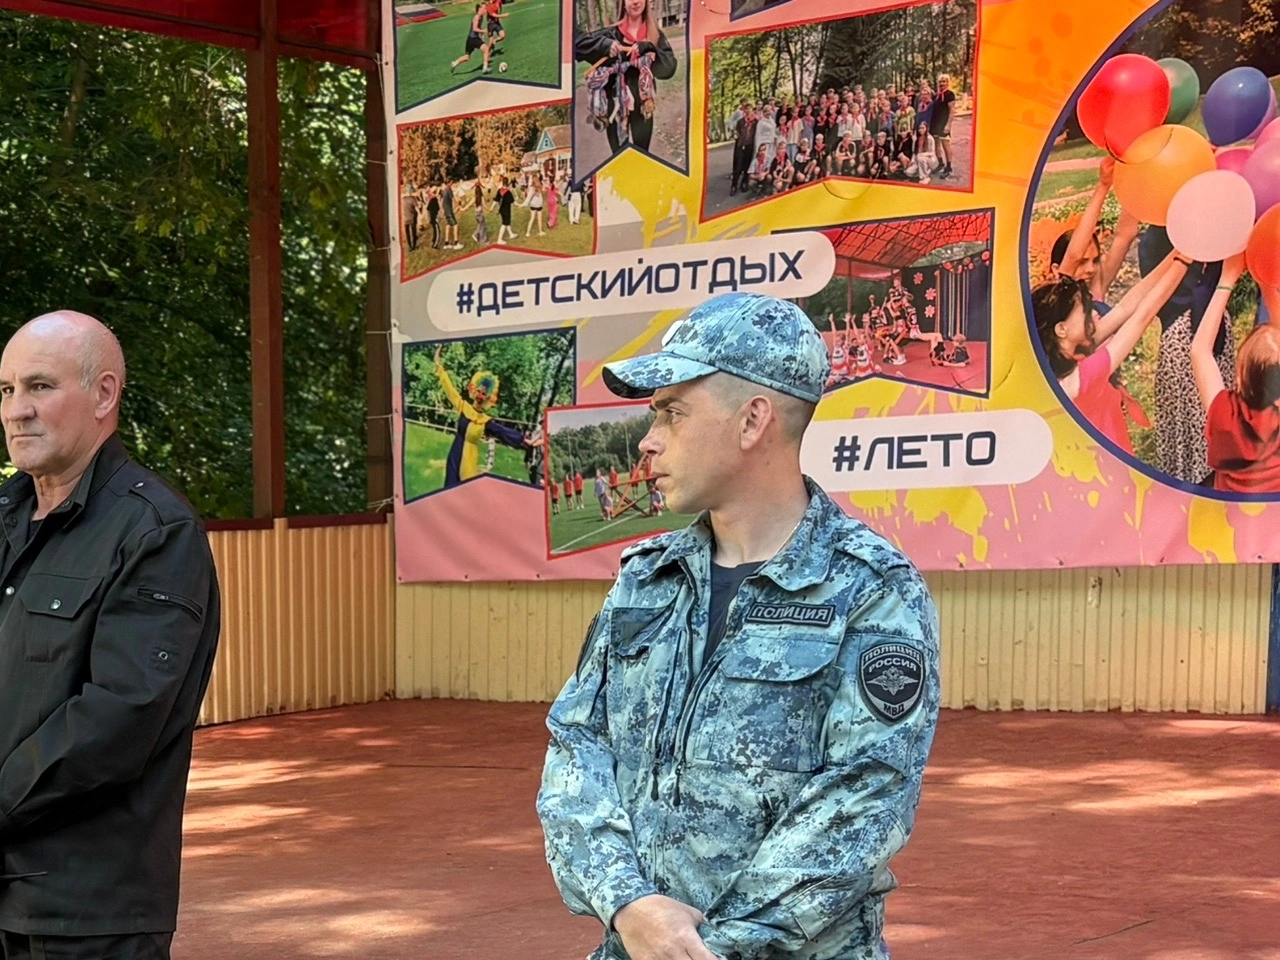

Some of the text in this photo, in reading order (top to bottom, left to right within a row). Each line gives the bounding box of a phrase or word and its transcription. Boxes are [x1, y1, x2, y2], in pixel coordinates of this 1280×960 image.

[456, 250, 805, 317] #ДЕТСКИЙОТДЫХ
[832, 431, 996, 472] #ЛЕТО
[751, 606, 829, 620] ПОЛИЦИЯ
[865, 645, 920, 661] ПОЛИЦИЯ
[868, 657, 917, 673] РОССИЯ
[883, 703, 905, 716] МВД
